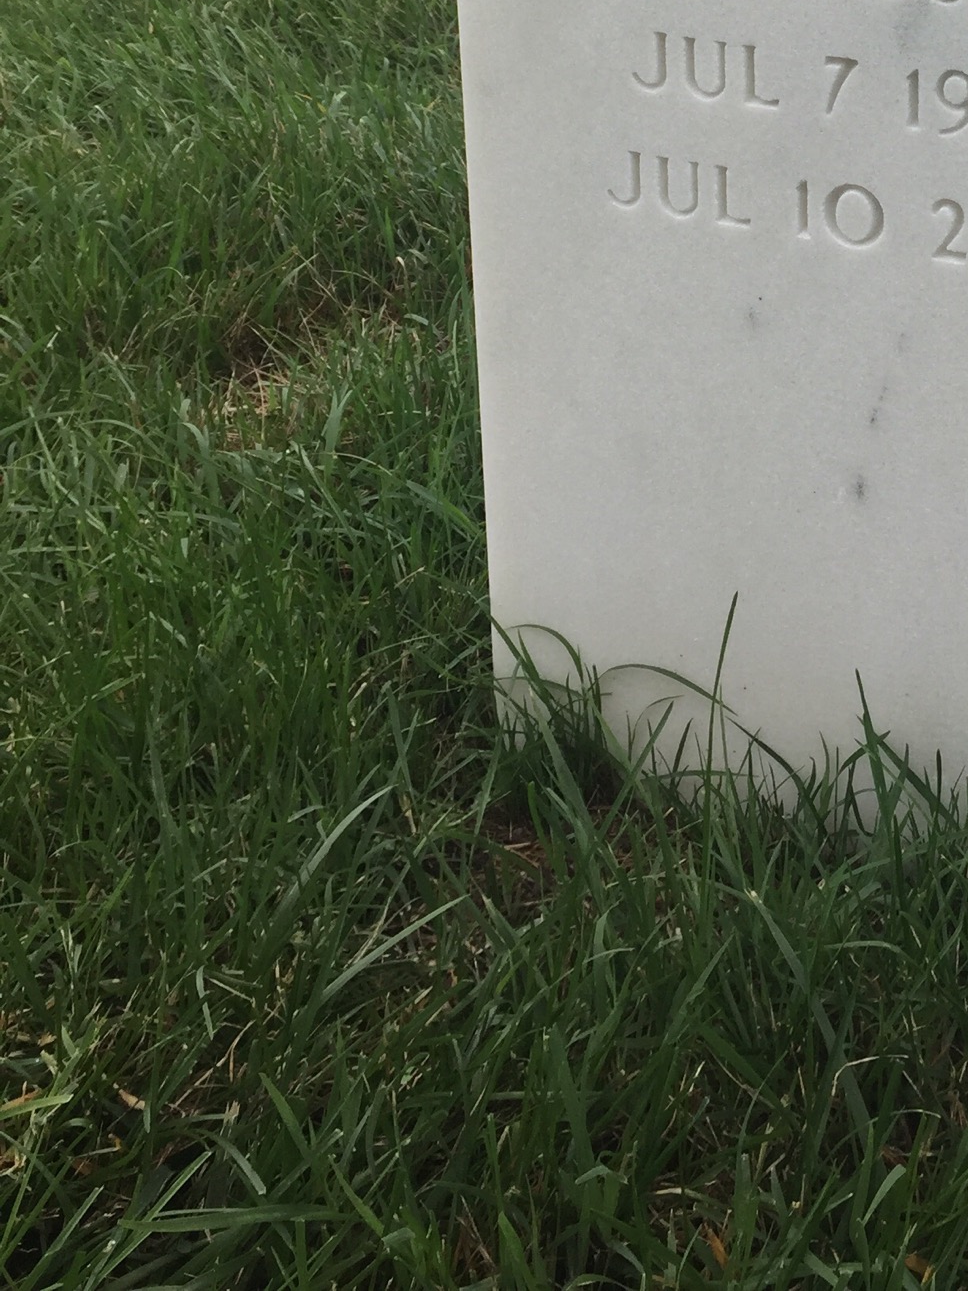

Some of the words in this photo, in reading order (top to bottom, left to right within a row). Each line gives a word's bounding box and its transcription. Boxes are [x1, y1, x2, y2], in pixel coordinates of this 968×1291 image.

[632, 31, 780, 110] JUL
[824, 55, 859, 115] 7
[607, 150, 751, 228] JUL
[796, 179, 885, 249] 10
